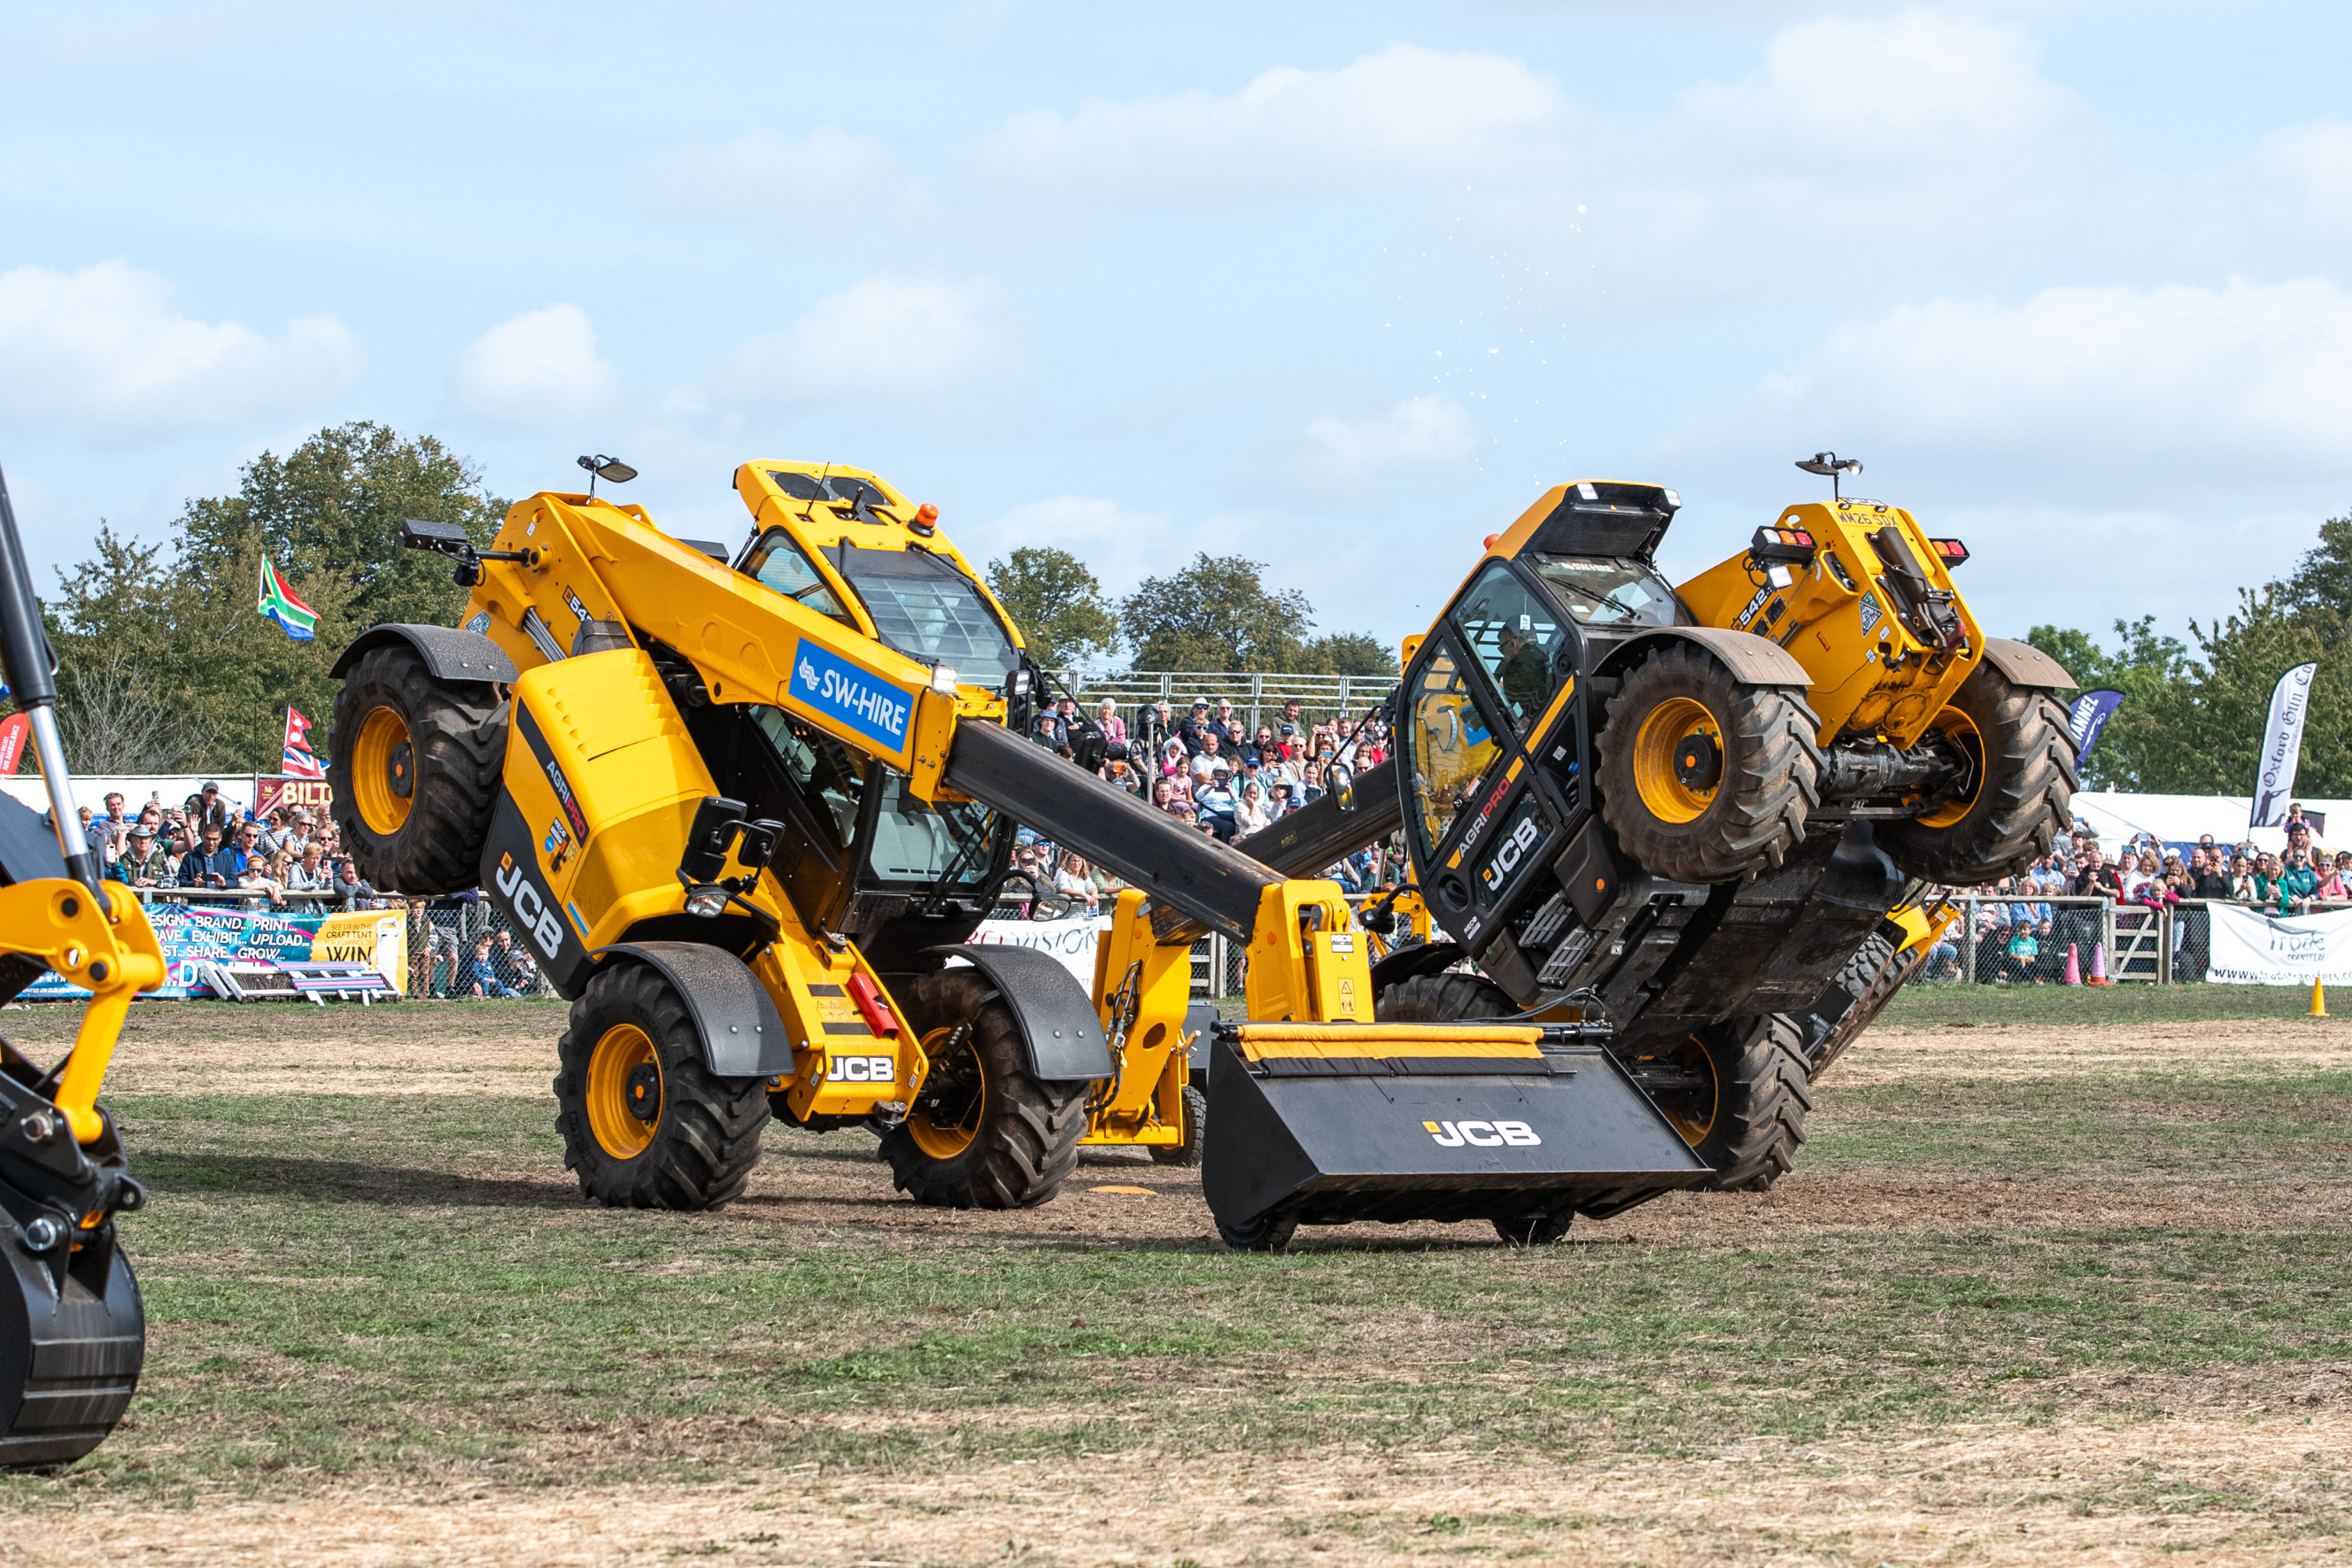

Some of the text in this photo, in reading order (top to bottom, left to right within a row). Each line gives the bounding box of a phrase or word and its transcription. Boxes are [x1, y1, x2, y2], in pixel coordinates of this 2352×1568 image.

[1836, 512, 1899, 527] WM26 SDX
[820, 668, 906, 736] SW-HIRE
[2070, 694, 2099, 741] ANNEL
[5, 724, 20, 761] AMBULANCE
[2263, 731, 2290, 788] Oxford
[2294, 665, 2312, 685] Co
[546, 760, 585, 838] AGRIPRO
[1458, 777, 1510, 859] AGRIPRO
[1488, 816, 1538, 892] JCB
[149, 914, 298, 931] ESIGN... BRAND... PRINT...
[495, 865, 564, 960] JCB
[152, 929, 310, 947] RAVE... EXHIBIT... UPLOAD...
[326, 931, 350, 939] CRAFT
[2266, 918, 2326, 952] Trade
[159, 945, 285, 960] ST... SHARE... GROW...
[2287, 953, 2325, 962] TRANSFERS
[826, 1057, 894, 1081] JCB
[1431, 1121, 1542, 1147] JCB
